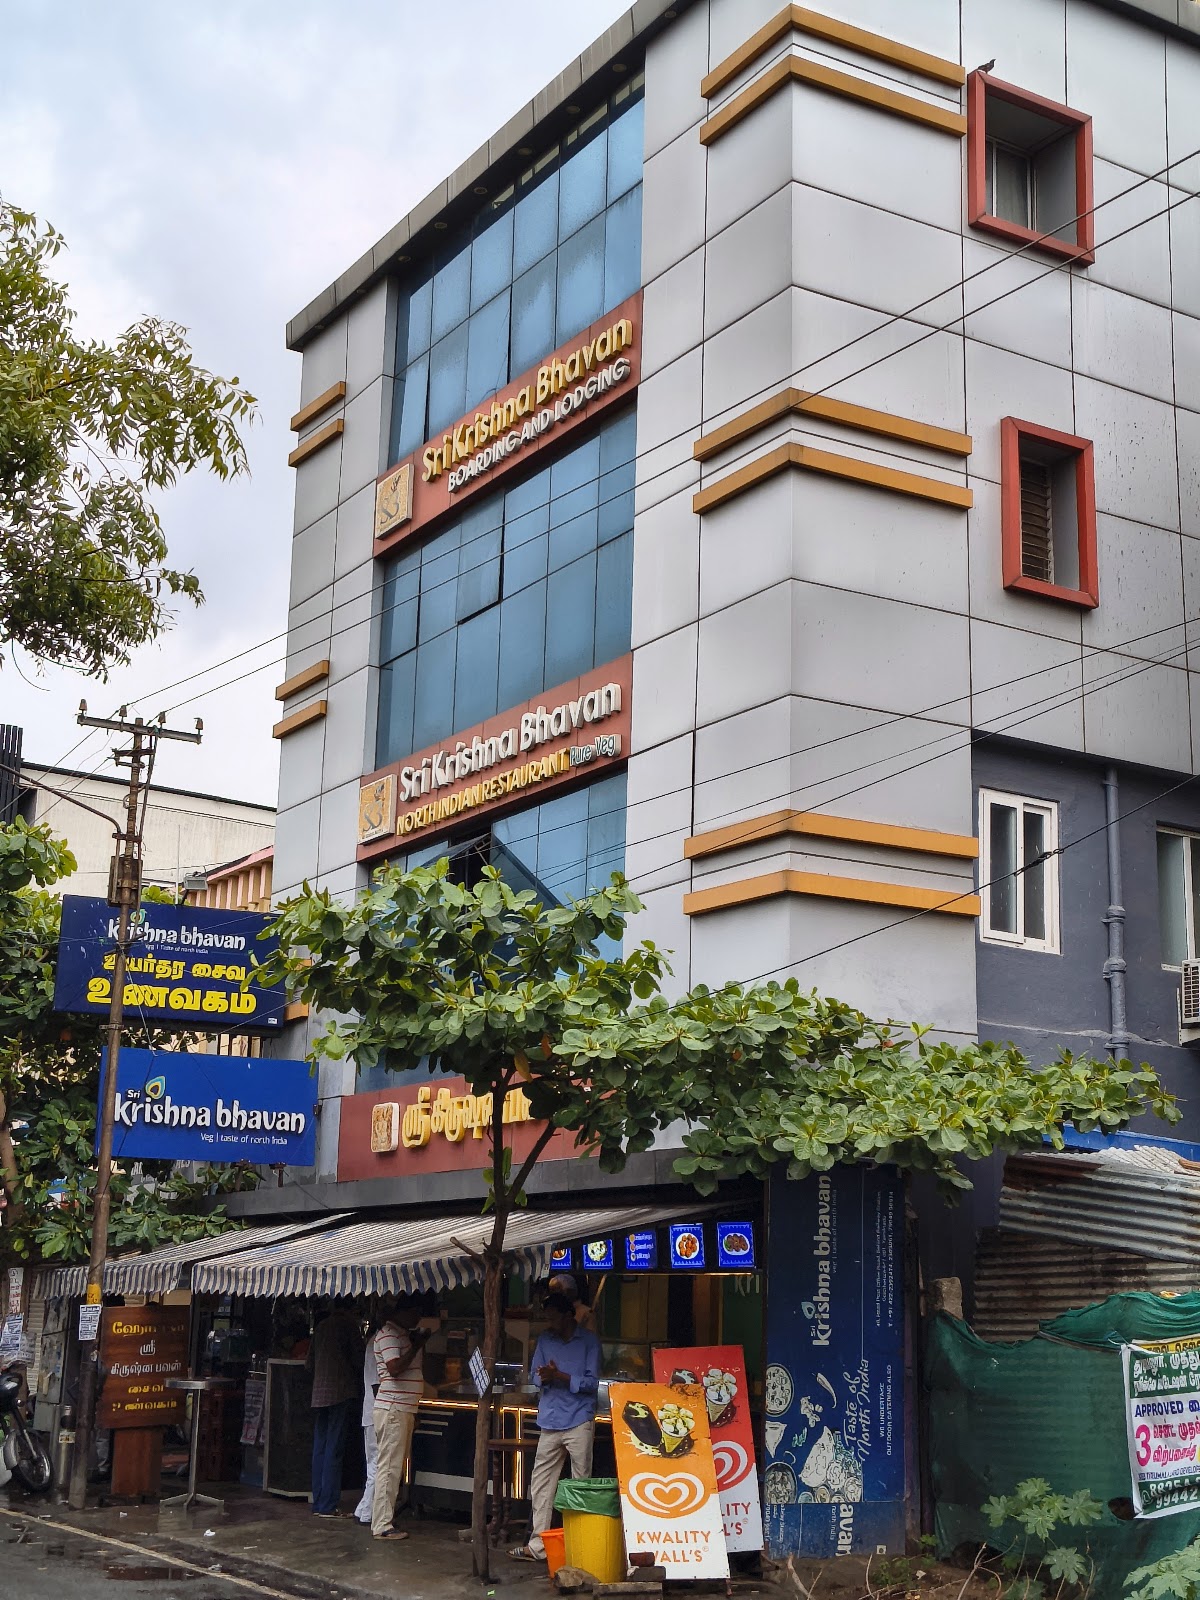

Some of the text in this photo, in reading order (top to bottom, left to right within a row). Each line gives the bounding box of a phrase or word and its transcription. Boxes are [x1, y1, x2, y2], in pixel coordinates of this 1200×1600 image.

[422, 318, 633, 483] Sri Krishna Bhavan
[448, 357, 630, 494] BOARDING AND LODGING
[400, 682, 621, 801] Sri Krishna Bhavan
[397, 805, 437, 837] NORTH
[436, 783, 483, 818] INDIAN
[482, 747, 569, 802] RESTAURANT
[569, 744, 596, 767] Pure
[595, 733, 621, 758] Veg
[181, 925, 246, 950] bhavan
[114, 1093, 305, 1134] krishna bhavan
[127, 1089, 140, 1098] Sri
[201, 1132, 214, 1143] Veg
[240, 1134, 249, 1144] of
[250, 1136, 270, 1144] north
[832, 1228, 836, 1236] of
[812, 1175, 832, 1346] krishna bhavan
[843, 1372, 860, 1447] Taste of
[857, 1359, 870, 1461] North India
[1135, 1400, 1184, 1418] APPROVED
[1135, 1424, 1151, 1467] 3
[636, 1531, 711, 1544] KWALITY
